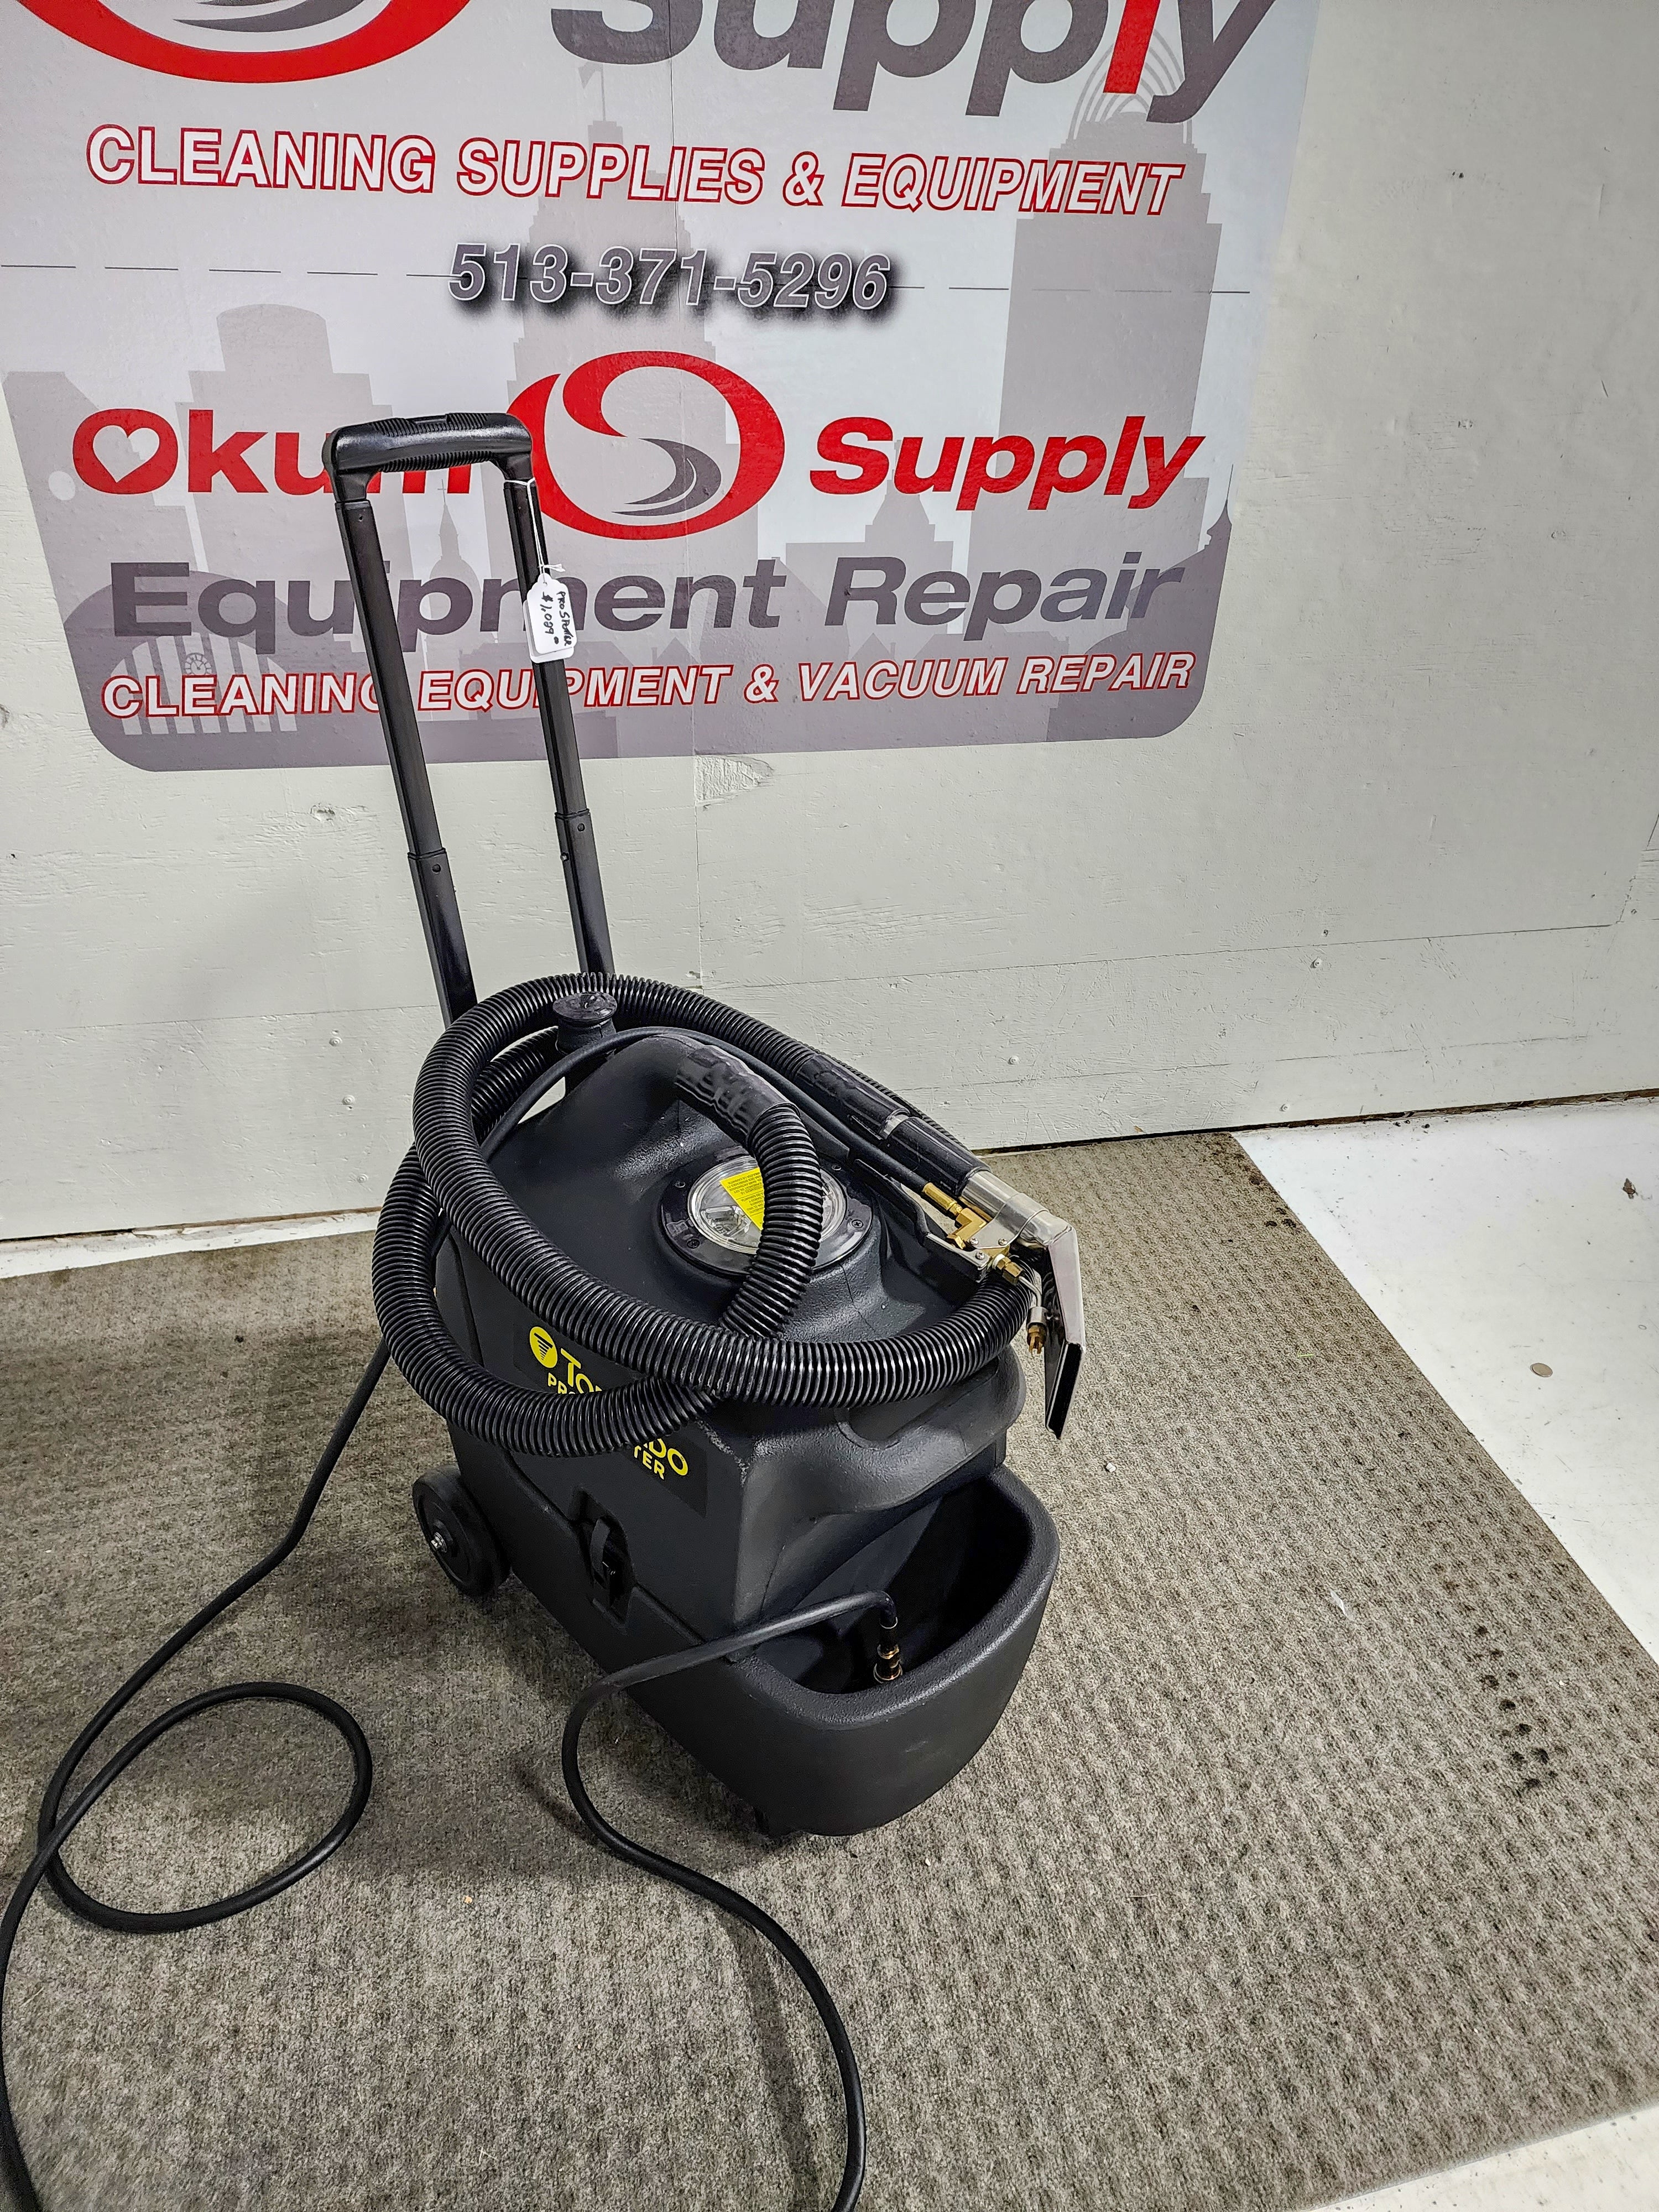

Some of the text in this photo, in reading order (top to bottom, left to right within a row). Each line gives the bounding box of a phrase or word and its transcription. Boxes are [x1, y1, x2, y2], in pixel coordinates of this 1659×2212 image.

[86, 124, 1186, 216] CLEANING SUPPLIES & EQUIPMENT
[447, 242, 891, 310] 513-371-5296
[809, 415, 1204, 511] Supply
[823, 551, 1185, 641] Repair
[743, 664, 779, 704] &
[799, 656, 1009, 702] VACUUM
[1016, 651, 1196, 695] REPAIR
